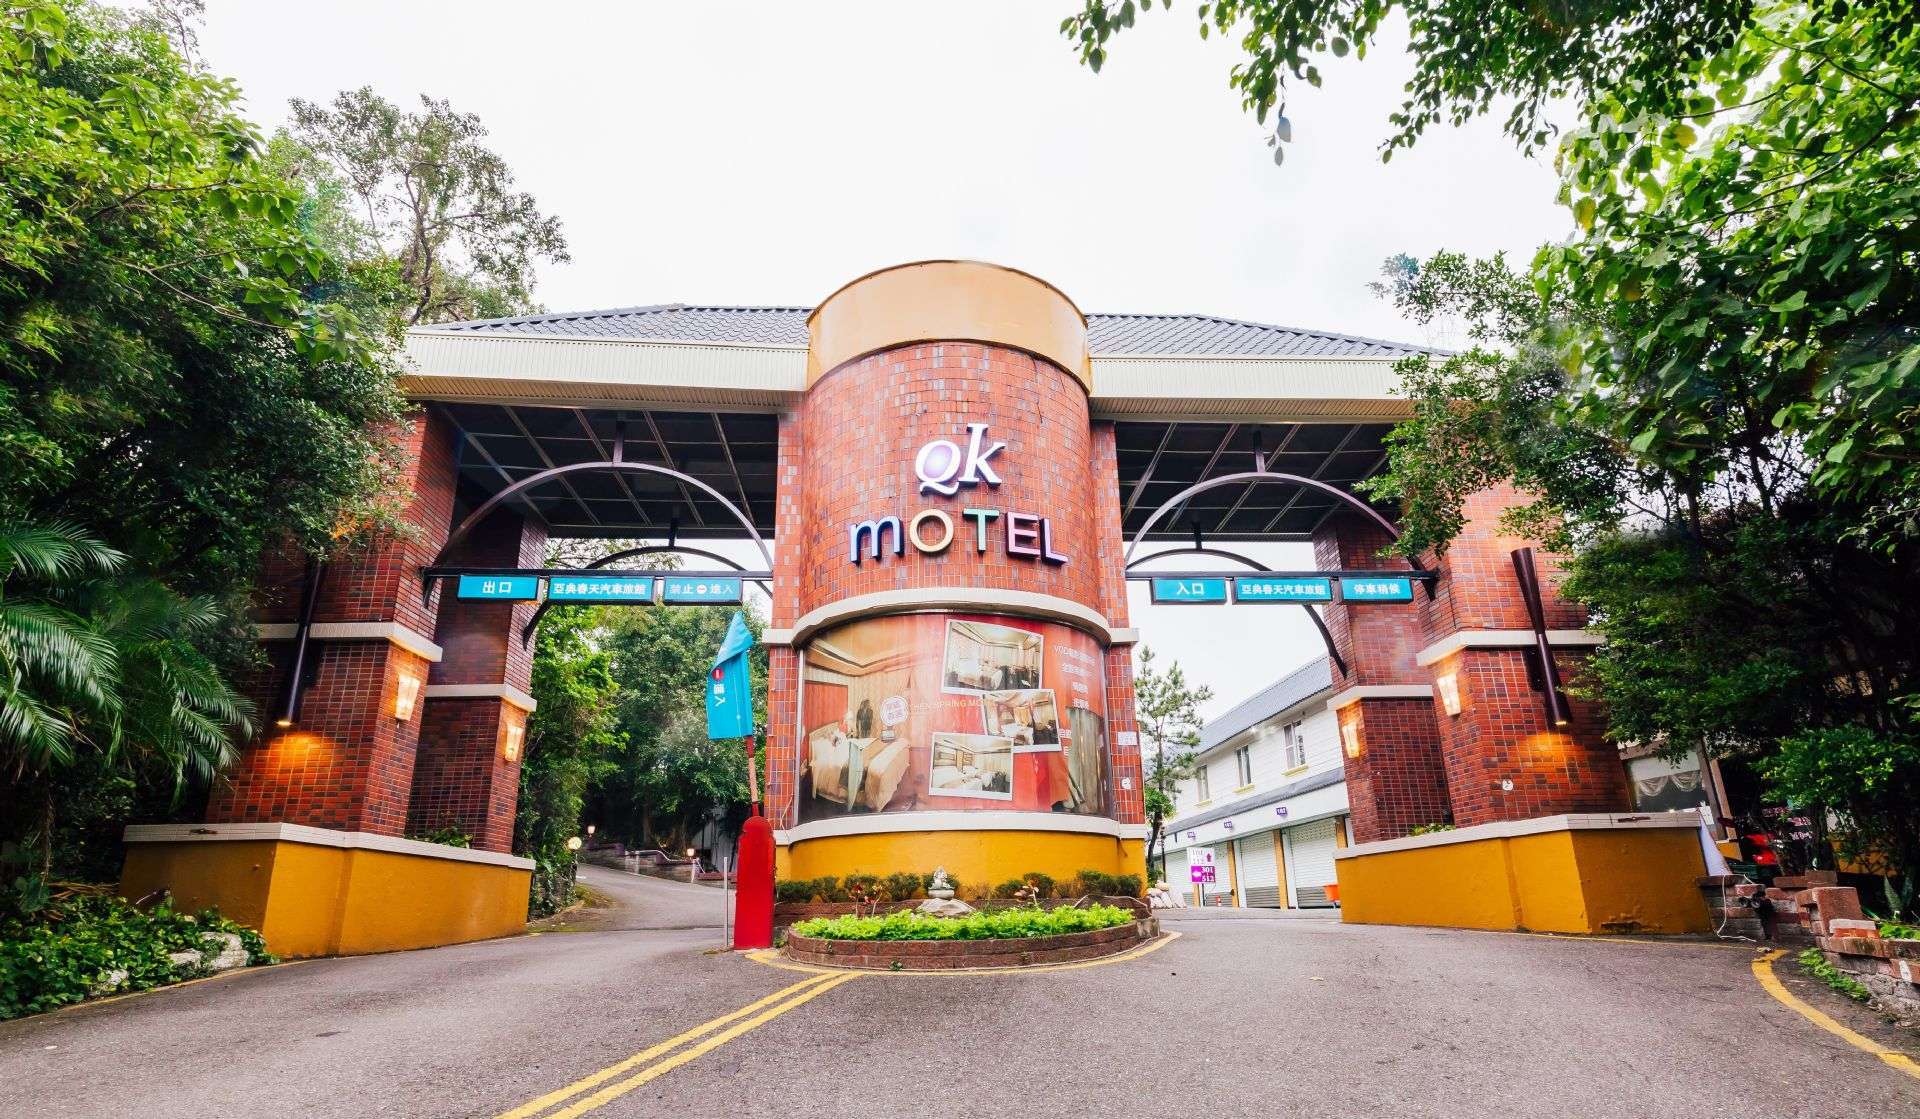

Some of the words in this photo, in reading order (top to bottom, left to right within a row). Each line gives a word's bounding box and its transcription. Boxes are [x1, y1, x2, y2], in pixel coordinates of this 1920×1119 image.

[482, 580, 512, 594] 出口
[553, 582, 647, 596] 亞典春天汽車旅館
[1176, 584, 1205, 595] 入口
